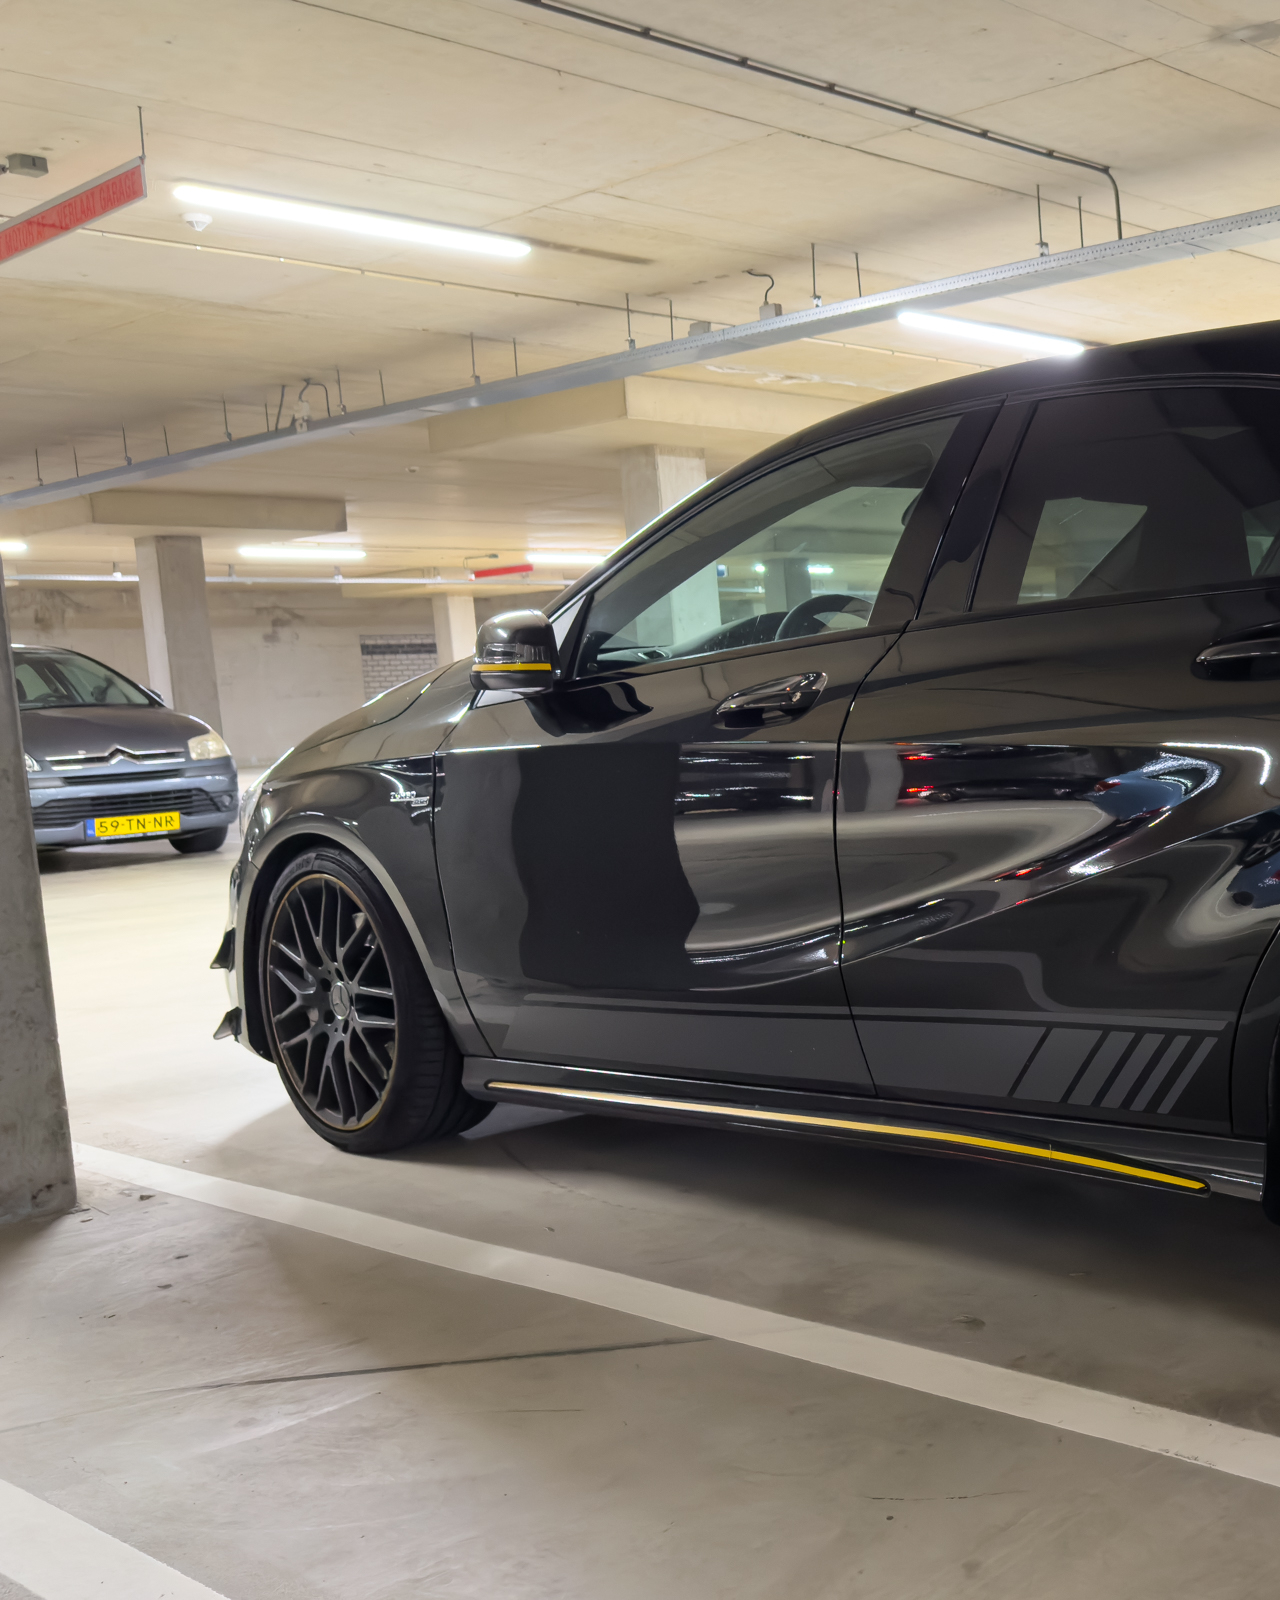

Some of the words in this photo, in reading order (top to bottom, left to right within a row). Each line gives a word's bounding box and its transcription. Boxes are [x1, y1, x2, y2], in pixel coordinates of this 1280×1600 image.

[57, 190, 96, 226] VERLAAT
[100, 170, 138, 211] GARAGE
[97, 815, 176, 833] 59-TN-NR
